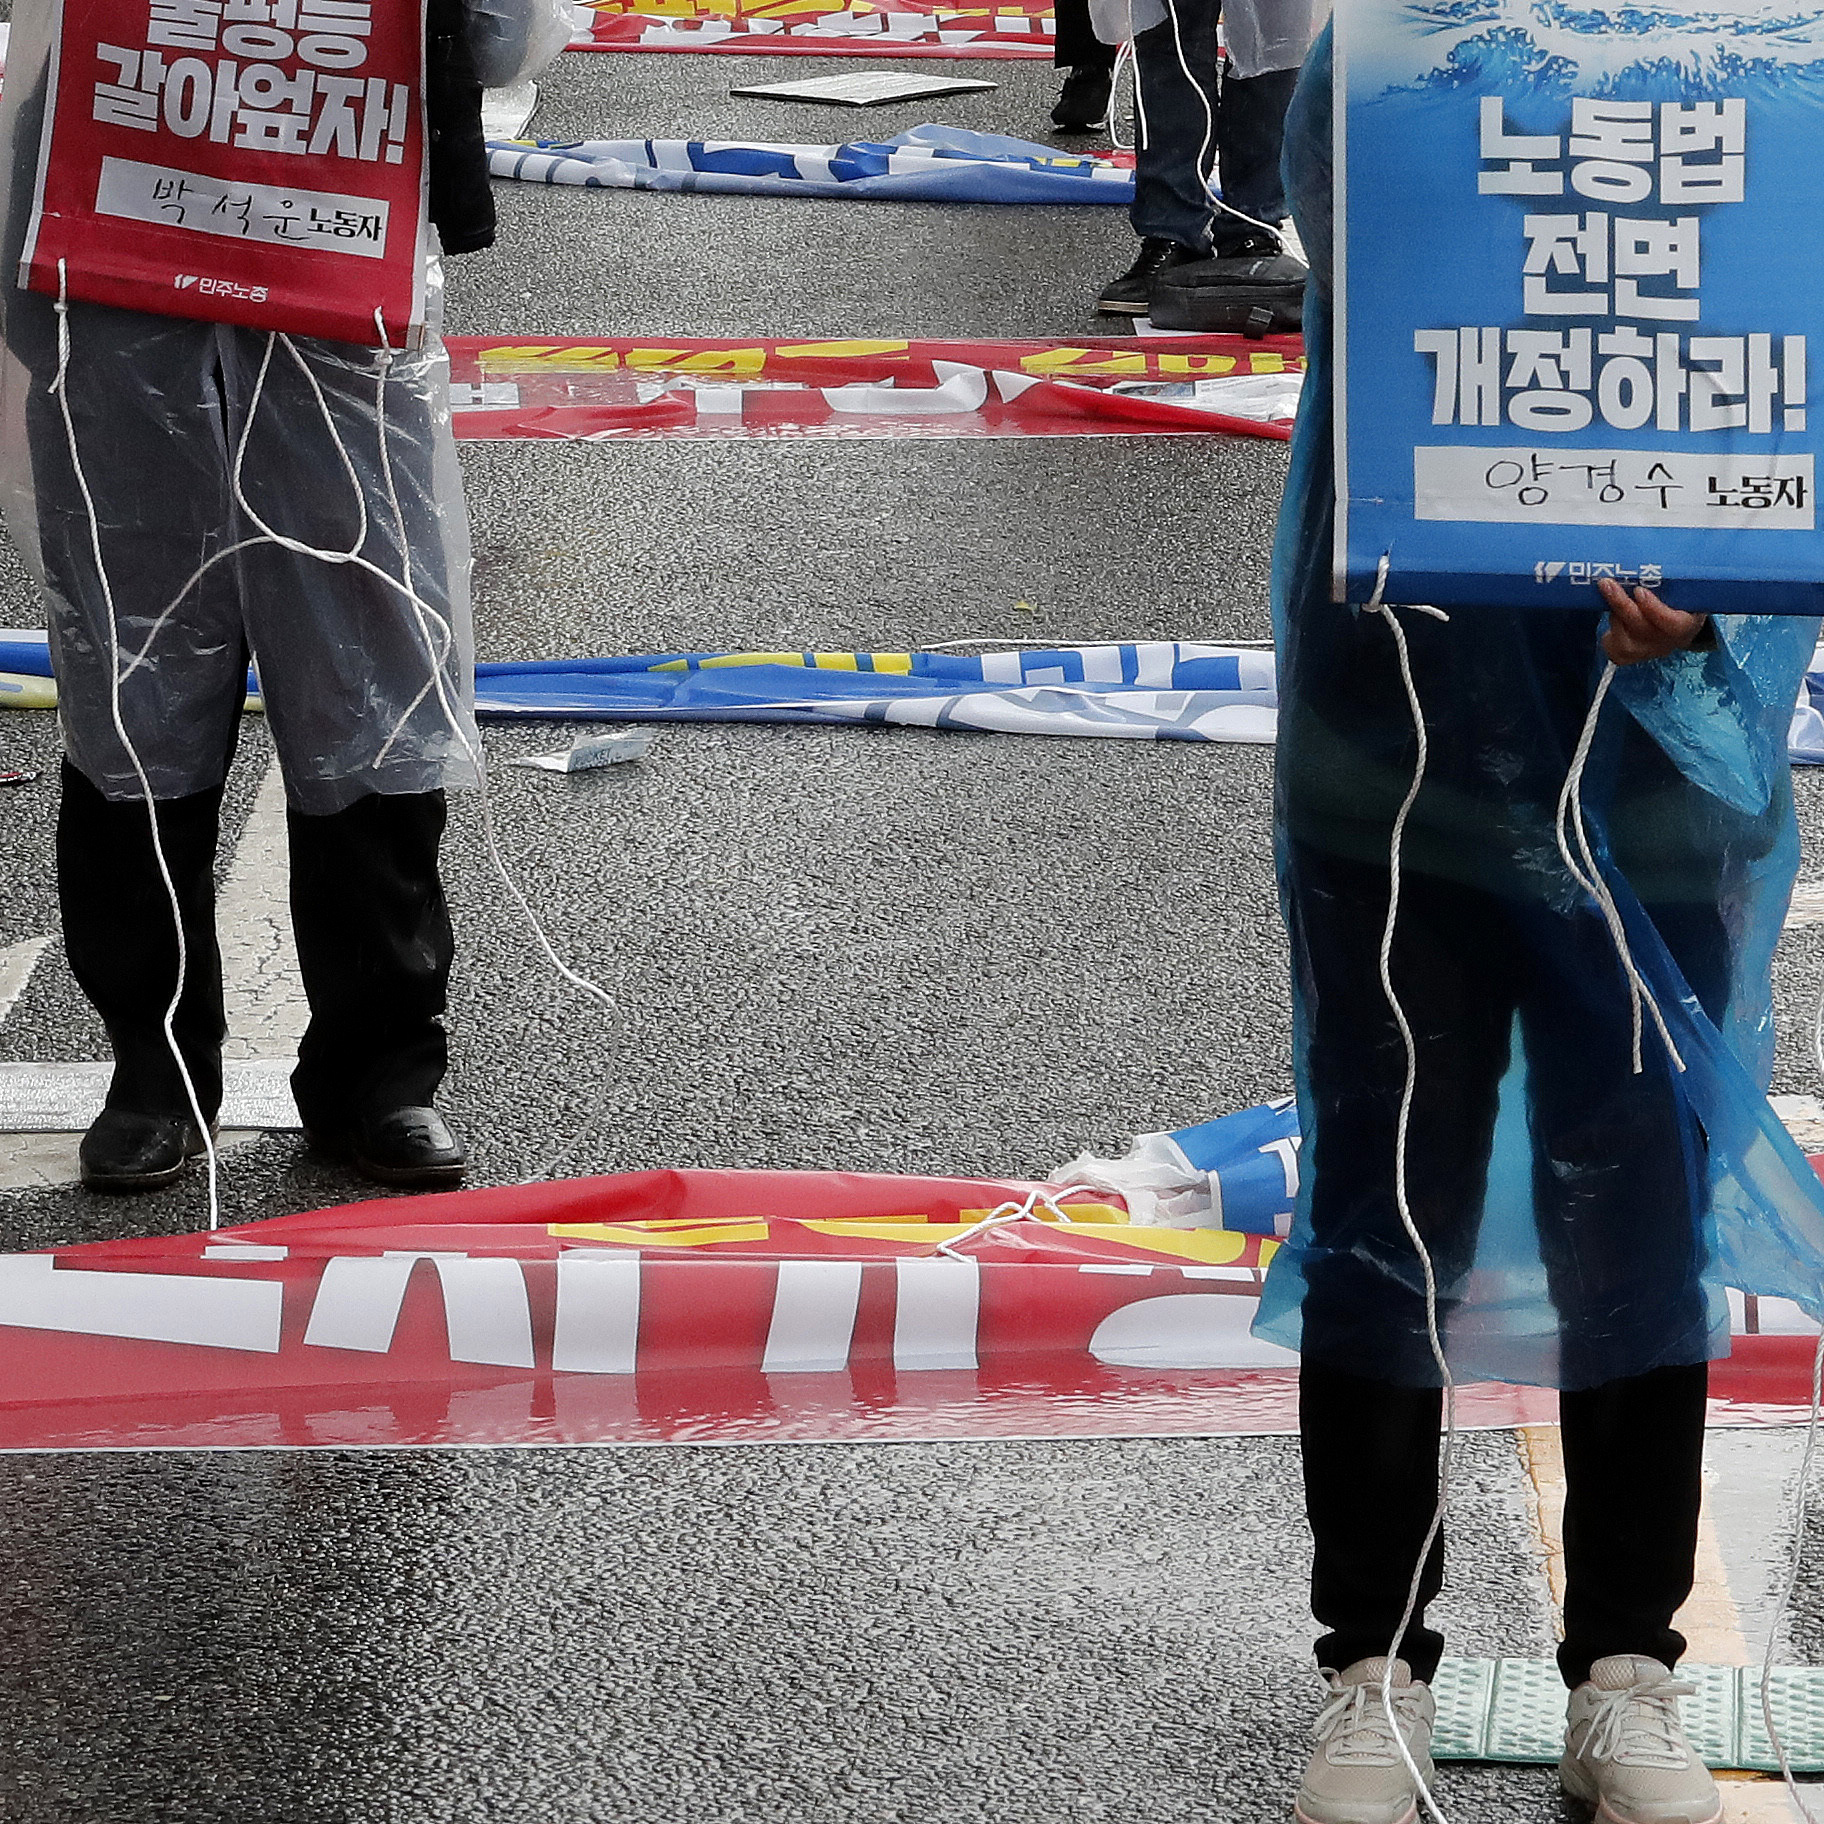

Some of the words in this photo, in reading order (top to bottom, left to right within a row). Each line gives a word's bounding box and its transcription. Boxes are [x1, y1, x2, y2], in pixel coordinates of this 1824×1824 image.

[91, 42, 411, 166] 갈아엎자!
[1477, 94, 1747, 205] 노동법
[306, 209, 384, 243] 노동자
[198, 276, 270, 304] 민주노총
[1521, 212, 1701, 322] 전면
[1413, 325, 1808, 435] 개정하라!
[1706, 474, 1810, 513] 노동자
[1567, 560, 1663, 589] 민주노총
